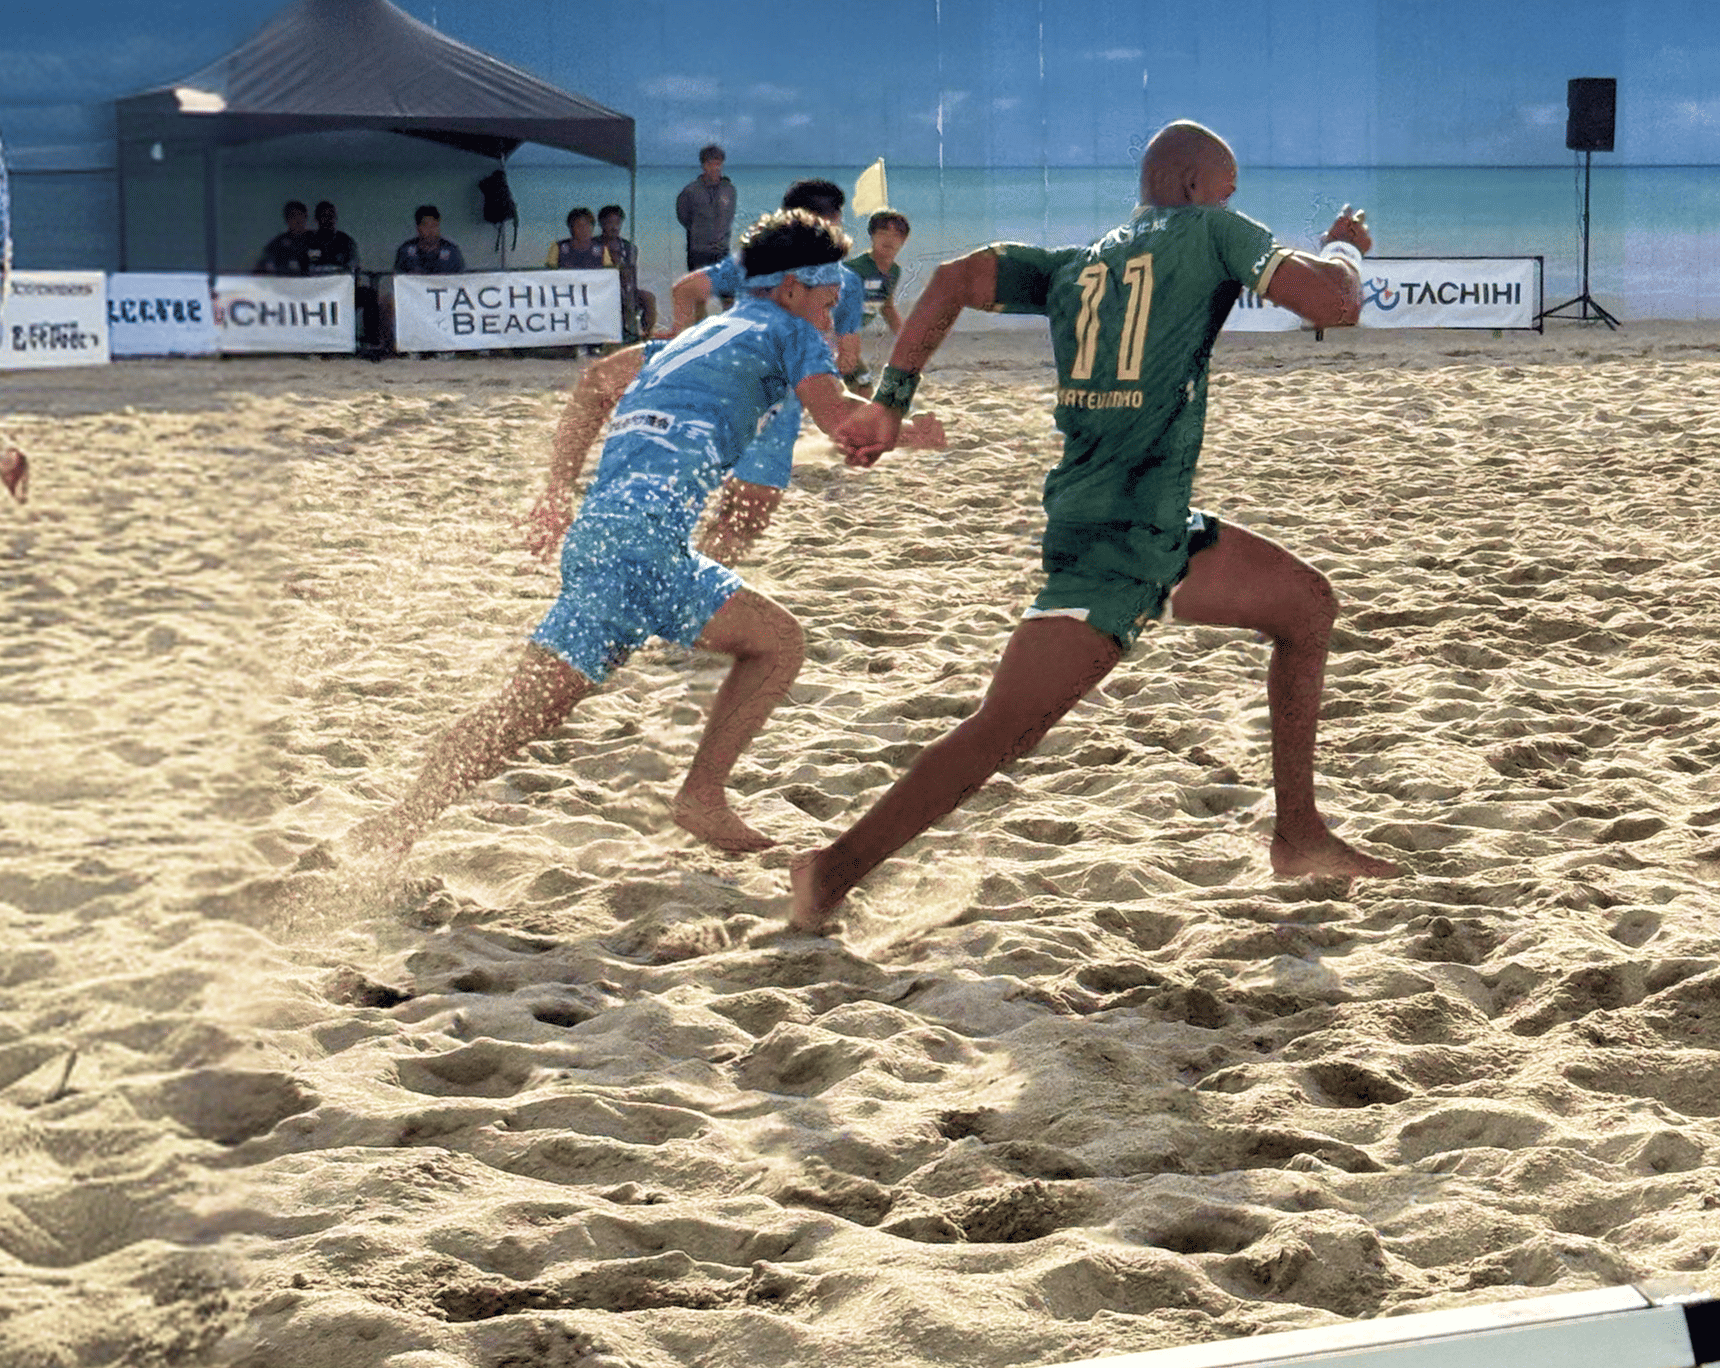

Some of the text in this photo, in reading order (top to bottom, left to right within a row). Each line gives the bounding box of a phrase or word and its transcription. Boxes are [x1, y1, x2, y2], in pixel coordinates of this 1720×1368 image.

[426, 284, 590, 312] TACHIHI
[1400, 281, 1521, 305] TACHIHI
[223, 300, 339, 328] CHIHI
[451, 312, 571, 336] BEACH
[1070, 253, 1154, 381] 11
